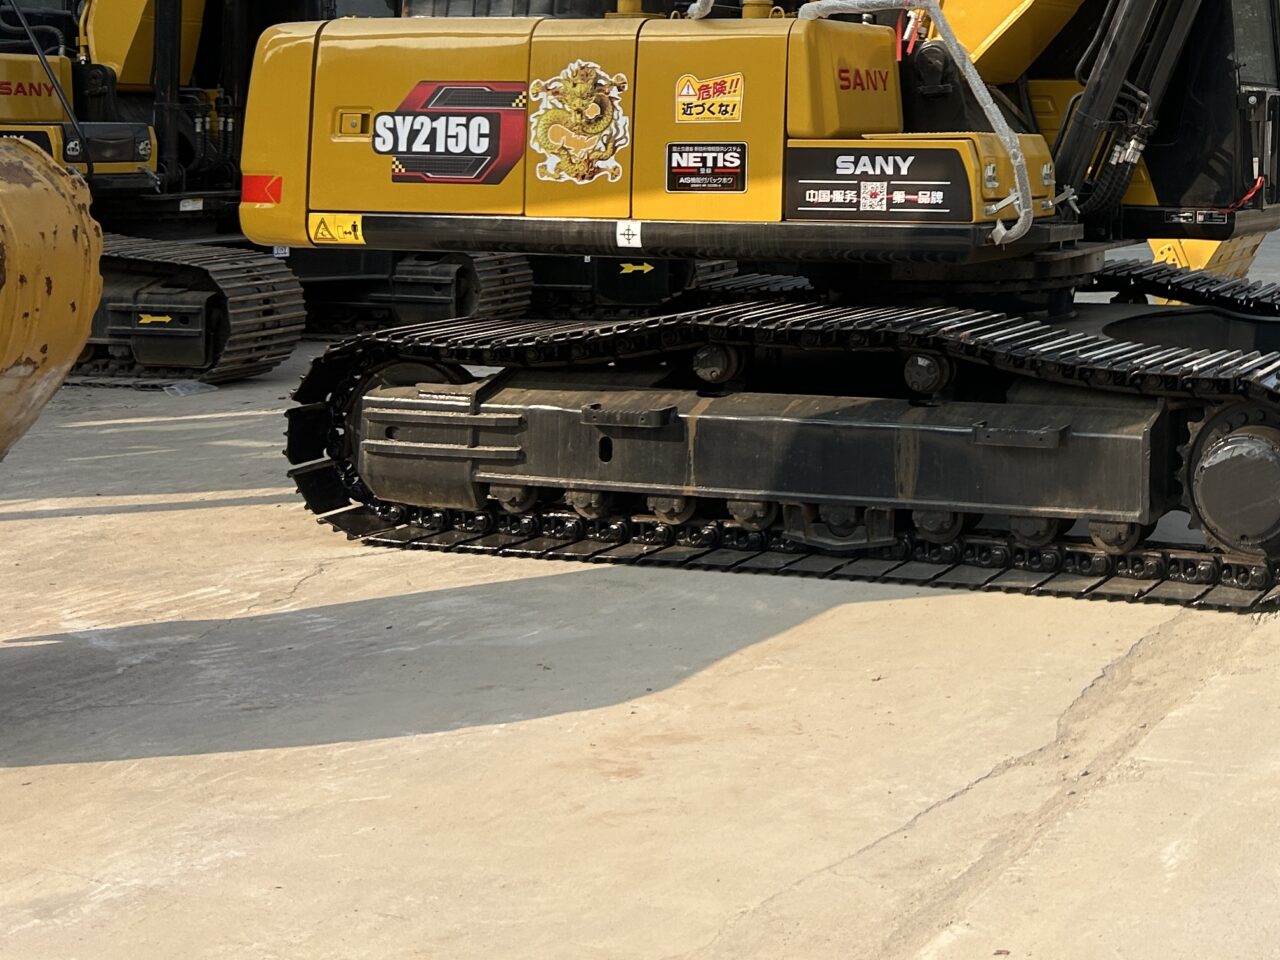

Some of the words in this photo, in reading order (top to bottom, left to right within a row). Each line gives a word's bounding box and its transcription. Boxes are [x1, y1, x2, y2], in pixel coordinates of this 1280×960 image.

[838, 67, 889, 92] SANY
[0, 81, 54, 97] SANY
[697, 78, 740, 101] 危険!!
[682, 102, 737, 116] 近づくな!
[374, 114, 490, 154] SY215C
[671, 152, 741, 167] NETIS
[835, 155, 915, 176] SANY
[892, 190, 944, 204] 第一品牌
